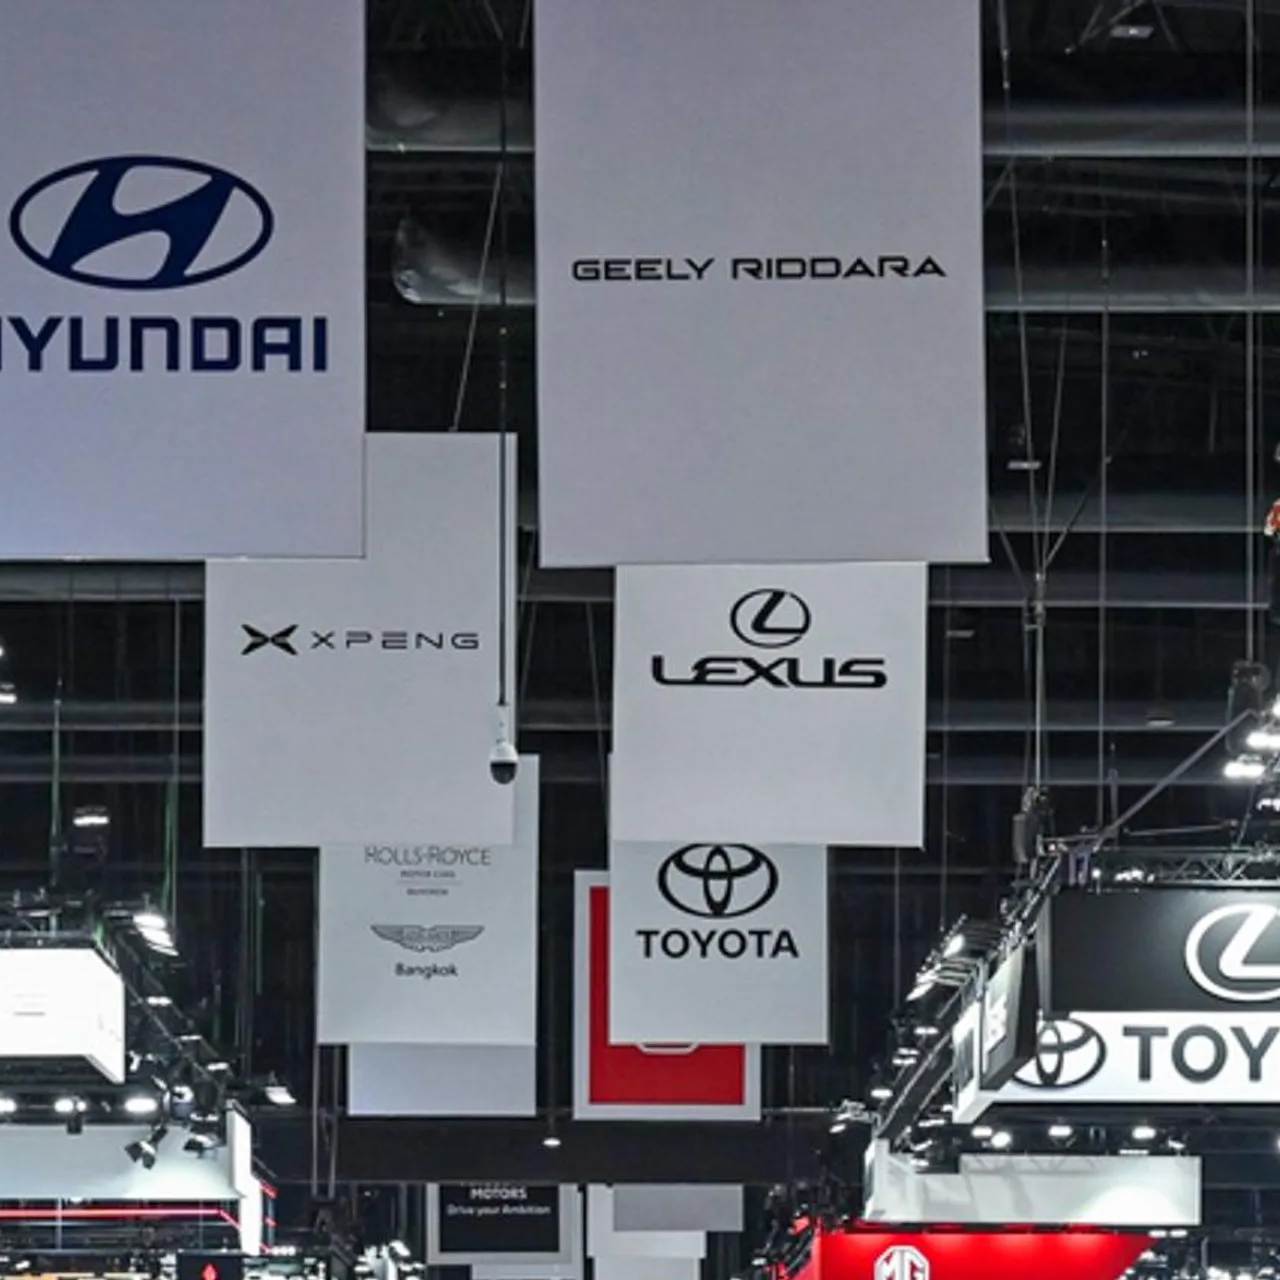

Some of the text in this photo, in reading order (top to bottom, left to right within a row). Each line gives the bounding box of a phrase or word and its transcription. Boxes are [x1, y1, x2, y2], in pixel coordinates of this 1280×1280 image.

[572, 257, 947, 281] GEELY RIDDARA
[311, 631, 480, 650] XPENG
[652, 655, 888, 689] LEXUS
[364, 845, 492, 866] ROLLS-ROYCE
[636, 929, 799, 959] TOYOTA
[395, 962, 458, 980] Bangkok
[470, 1187, 527, 1199] MOTORS
[447, 1204, 474, 1215] Drive
[502, 1203, 551, 1215] Ambition
